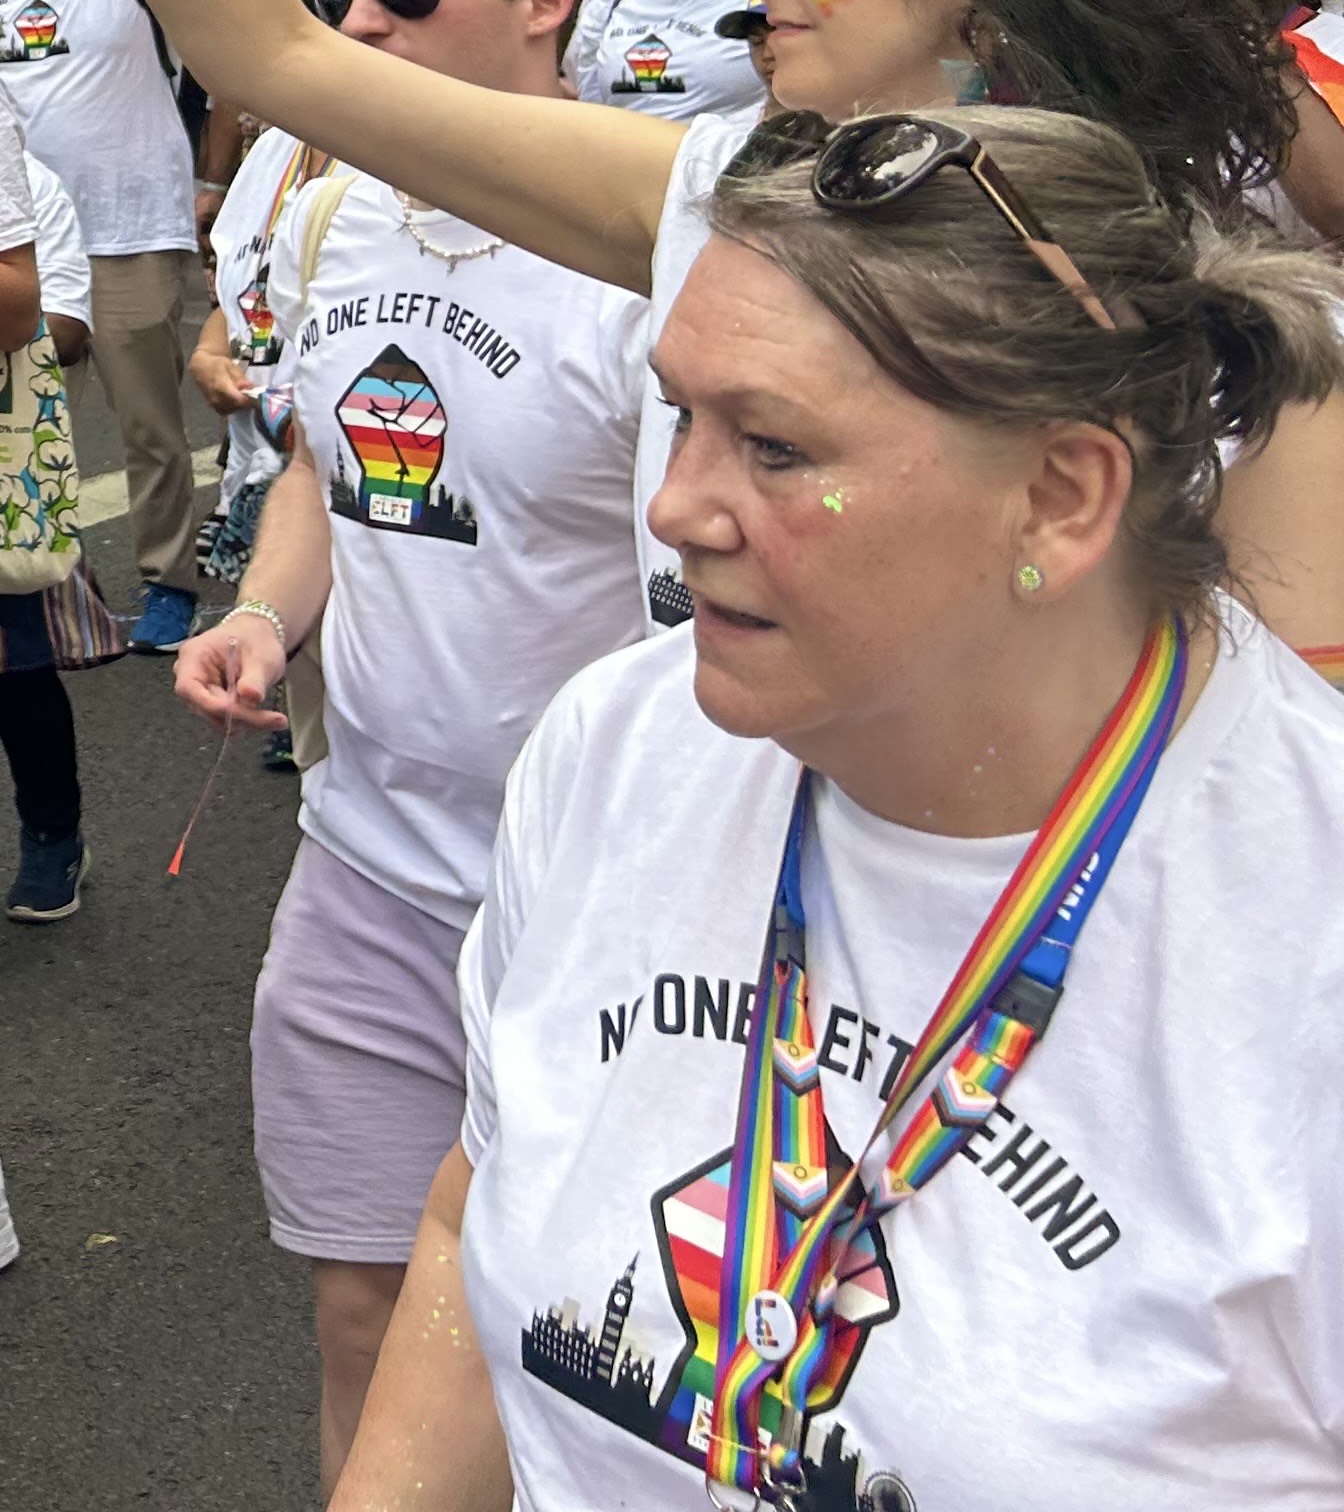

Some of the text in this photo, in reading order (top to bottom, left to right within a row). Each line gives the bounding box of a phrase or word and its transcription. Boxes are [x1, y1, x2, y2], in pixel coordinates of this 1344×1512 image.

[299, 292, 521, 380] NO ONE LEFT BEHIND
[372, 500, 409, 518] ELFT
[652, 972, 759, 1043] ONE
[817, 1003, 915, 1101] EFT
[958, 1101, 1122, 1272] EHIND
